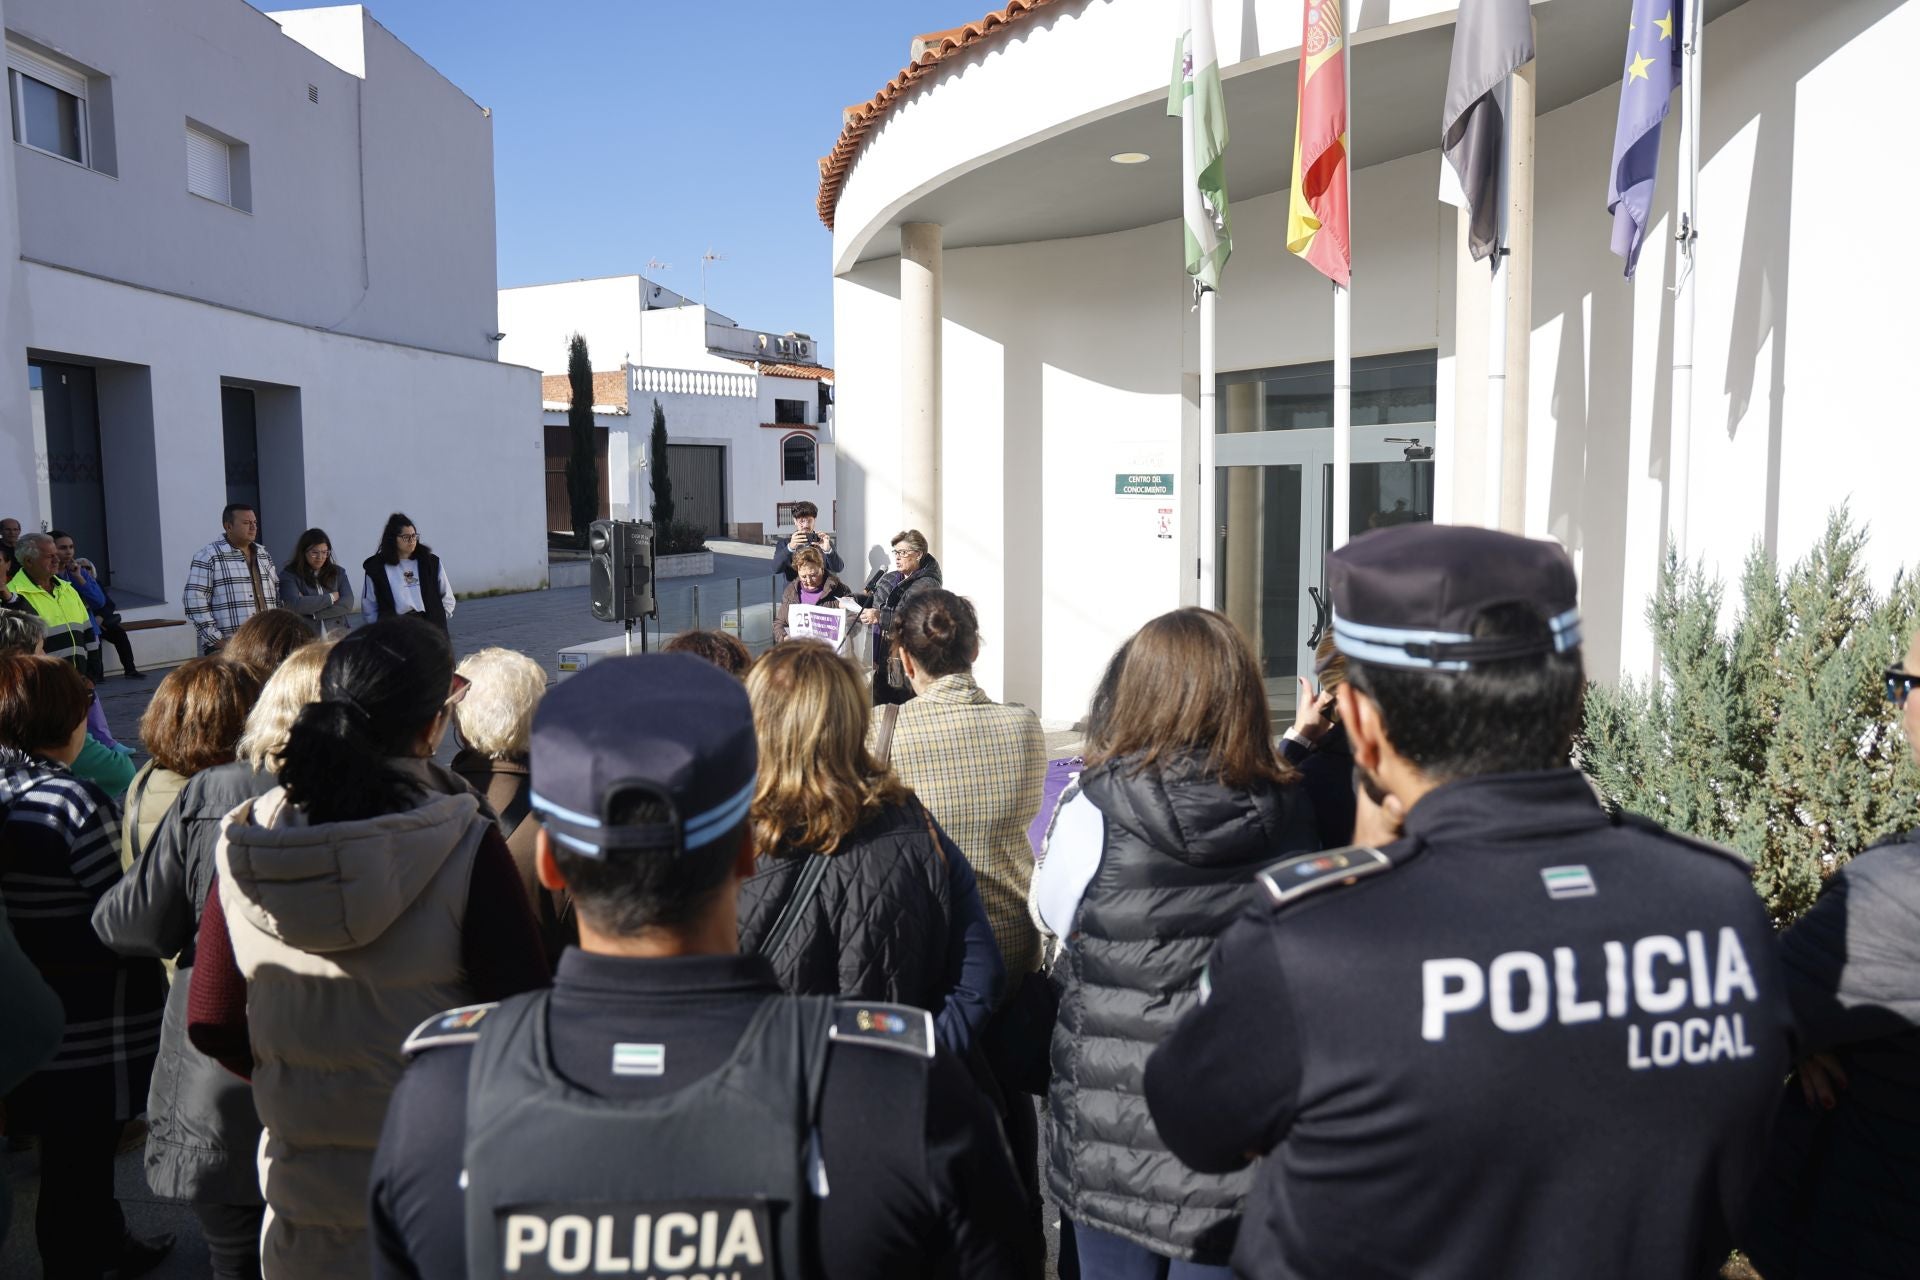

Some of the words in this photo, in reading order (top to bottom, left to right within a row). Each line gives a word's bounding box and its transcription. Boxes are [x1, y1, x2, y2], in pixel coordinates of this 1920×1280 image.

[1128, 475, 1151, 483] CENTRO
[1152, 475, 1162, 483] DEL
[796, 612, 810, 628] 25
[1421, 926, 1759, 1041] POLICIA
[1627, 1012, 1755, 1070] LOCAL
[504, 1208, 764, 1273] POLICIA
